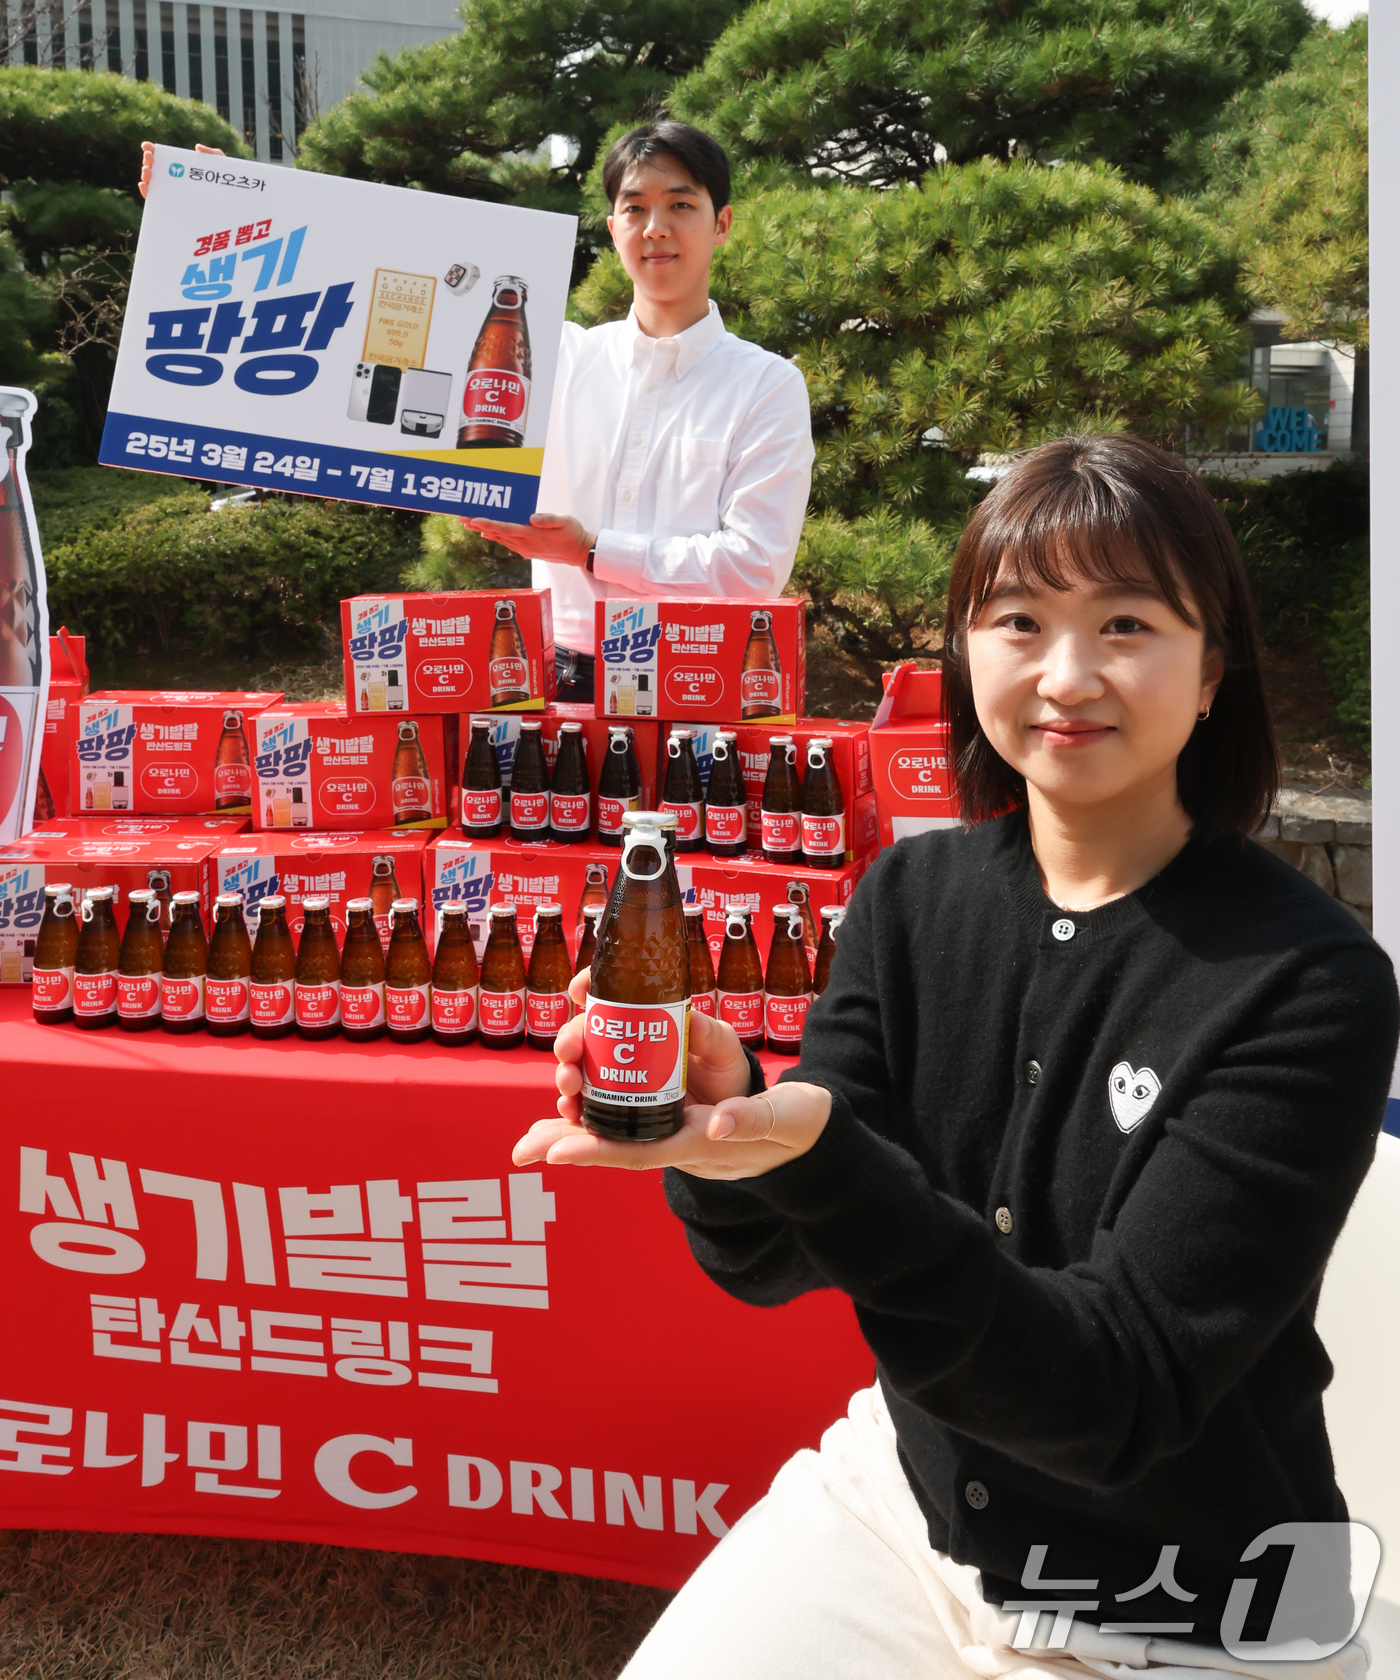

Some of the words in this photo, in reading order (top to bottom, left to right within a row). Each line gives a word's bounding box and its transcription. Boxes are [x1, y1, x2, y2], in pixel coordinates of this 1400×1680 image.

[188, 166, 267, 192] 동아오츠카
[193, 229, 232, 256] 경품
[236, 218, 272, 245] 뽑고
[179, 225, 308, 301] 생기
[382, 283, 426, 296] GOLD
[380, 291, 425, 305] EXCHANGE
[378, 300, 424, 315] 한국금거래소
[378, 317, 395, 327] FINE
[397, 320, 419, 330] GOLD
[145, 281, 355, 396] 팡팡
[386, 328, 409, 338] 999.9
[389, 338, 403, 348] 50g
[469, 378, 520, 395] 오로나민
[484, 390, 500, 403] C
[475, 404, 507, 415] DRINK
[1262, 428, 1324, 453] COME
[125, 431, 195, 463] 25년
[200, 441, 248, 472] 3월
[252, 451, 319, 482] 24일
[350, 465, 394, 493] 7월
[401, 472, 511, 509] 13일까지
[356, 604, 390, 635] 생기
[411, 614, 471, 635] 생기발랄
[609, 607, 644, 637] 생기
[665, 622, 725, 643] 생기발랄
[349, 618, 408, 661] 팡팡
[601, 621, 663, 664] 팡팡
[422, 664, 464, 675] 오로나민
[438, 674, 450, 685] C
[673, 671, 715, 684] 오로나민
[432, 685, 456, 693] DRINK
[688, 682, 700, 693] C
[682, 693, 706, 701] DRINK
[84, 708, 119, 737] 생기
[140, 722, 199, 740] 생기발랄
[76, 722, 137, 762] 팡팡
[261, 722, 295, 752] 생기
[316, 735, 374, 755] 생기발랄
[254, 735, 313, 778] 팡팡
[898, 756, 951, 770] 오로나민
[148, 767, 190, 778] 오로나민
[918, 769, 932, 783] C
[164, 777, 175, 787] C
[327, 782, 368, 793] 오로나민
[157, 787, 181, 795] DRINK
[911, 785, 942, 794] DRINK
[342, 792, 353, 802] C
[466, 794, 498, 805] 오로나민
[477, 804, 486, 813] C
[513, 798, 545, 808] 오로나민
[553, 800, 584, 810] 오로나민
[523, 807, 533, 816] C
[563, 809, 573, 818] C
[707, 811, 739, 822] 오로나민
[716, 821, 726, 830] C
[762, 819, 794, 829] 오로나민
[803, 821, 836, 832] 오로나민
[771, 828, 781, 836] C
[813, 831, 823, 840] C
[223, 859, 260, 891] 생기
[440, 856, 477, 885] 생기
[283, 871, 346, 892] 생기발랄
[498, 873, 560, 895] 생기발랄
[37, 985, 46, 994] C
[75, 978, 113, 990] 오로나민
[118, 981, 152, 992] 오로나민
[86, 990, 97, 1000] C
[206, 985, 242, 996] 오로나민
[250, 989, 284, 1000] 오로나민
[297, 990, 332, 1001] 오로나민
[126, 992, 136, 1001] C
[167, 995, 177, 1004] C
[216, 996, 226, 1006] C
[341, 991, 373, 1003] 오로나민
[386, 993, 419, 1004] 오로나민
[433, 996, 469, 1008] 오로나민
[260, 1000, 270, 1010] C
[307, 1002, 318, 1011] C
[349, 1003, 359, 1012] C
[481, 997, 518, 1009] 오로나민
[528, 998, 564, 1010] 오로나민
[724, 998, 761, 1011] 오로나민
[770, 1001, 808, 1013] 오로나민
[395, 1005, 405, 1014] C
[443, 1007, 454, 1017] C
[493, 1009, 504, 1019] C
[539, 1010, 550, 1020] C
[737, 1010, 749, 1020] C
[438, 1017, 461, 1025] DRINK
[783, 1013, 794, 1023] C
[534, 1020, 557, 1028] DRINK
[590, 1014, 669, 1043] 오로나민
[732, 1020, 755, 1028] DRINK
[777, 1024, 801, 1032] DRINK
[613, 1043, 635, 1065] C
[600, 1066, 649, 1084] DRINK
[634, 1095, 658, 1103] DRINK
[19, 1145, 557, 1310] 생기발랄
[89, 1293, 499, 1394] 탄산드링크
[313, 1433, 418, 1510] C
[446, 1453, 731, 1539] DRINK
